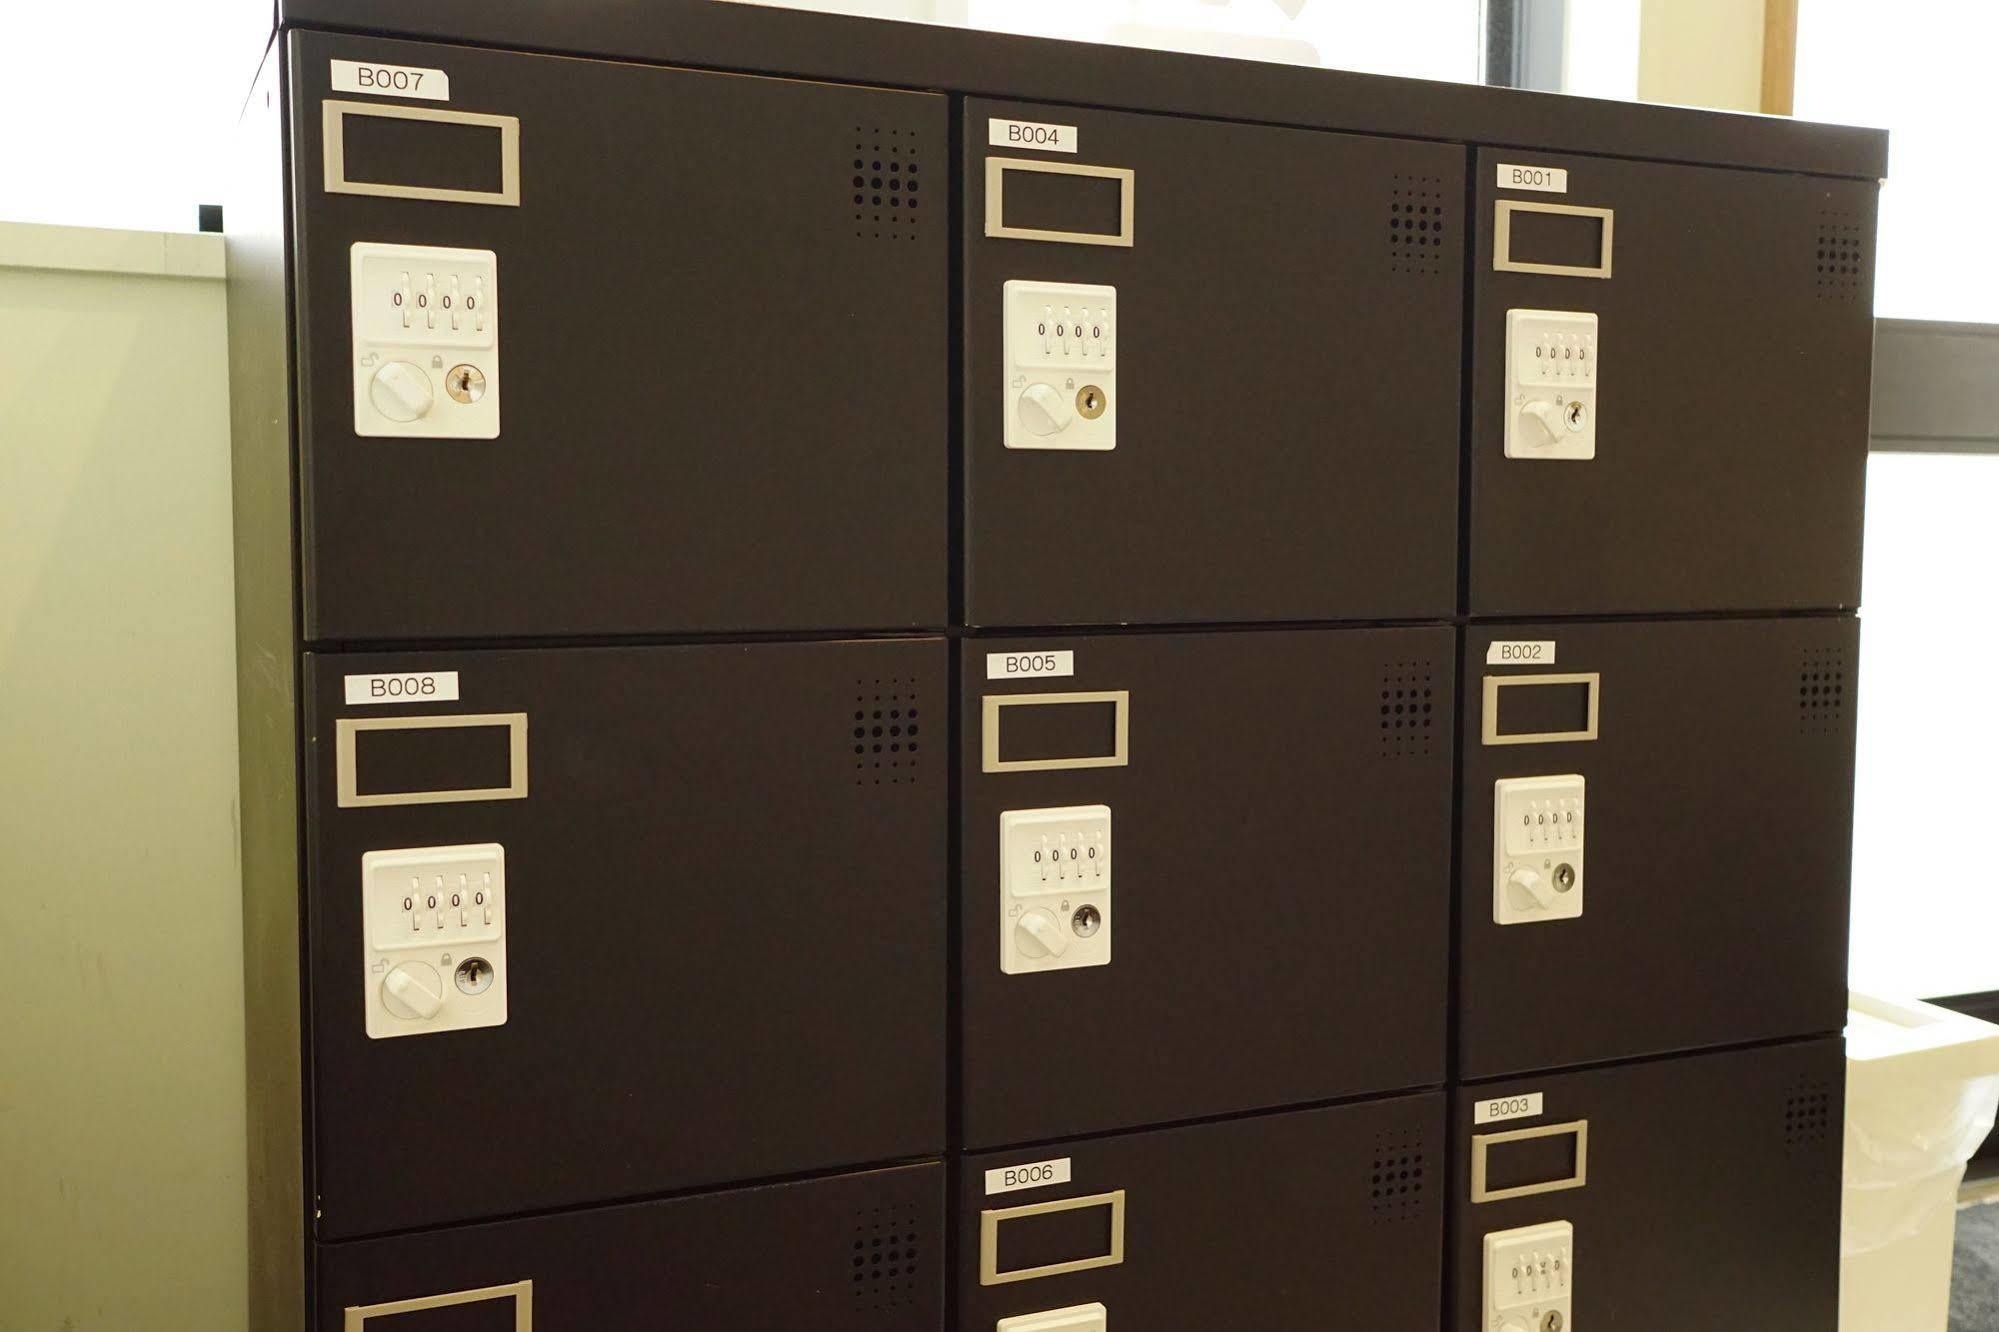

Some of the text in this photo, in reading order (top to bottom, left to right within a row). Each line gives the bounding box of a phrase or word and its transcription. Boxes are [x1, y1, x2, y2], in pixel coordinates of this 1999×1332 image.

[358, 67, 424, 92] B007
[1008, 124, 1060, 145] B004
[1512, 168, 1552, 187] B001
[1501, 644, 1542, 659] B002
[1006, 655, 1056, 673] B005
[370, 676, 436, 697] B008
[1489, 1098, 1529, 1118] B003
[1004, 1164, 1053, 1187] B006
